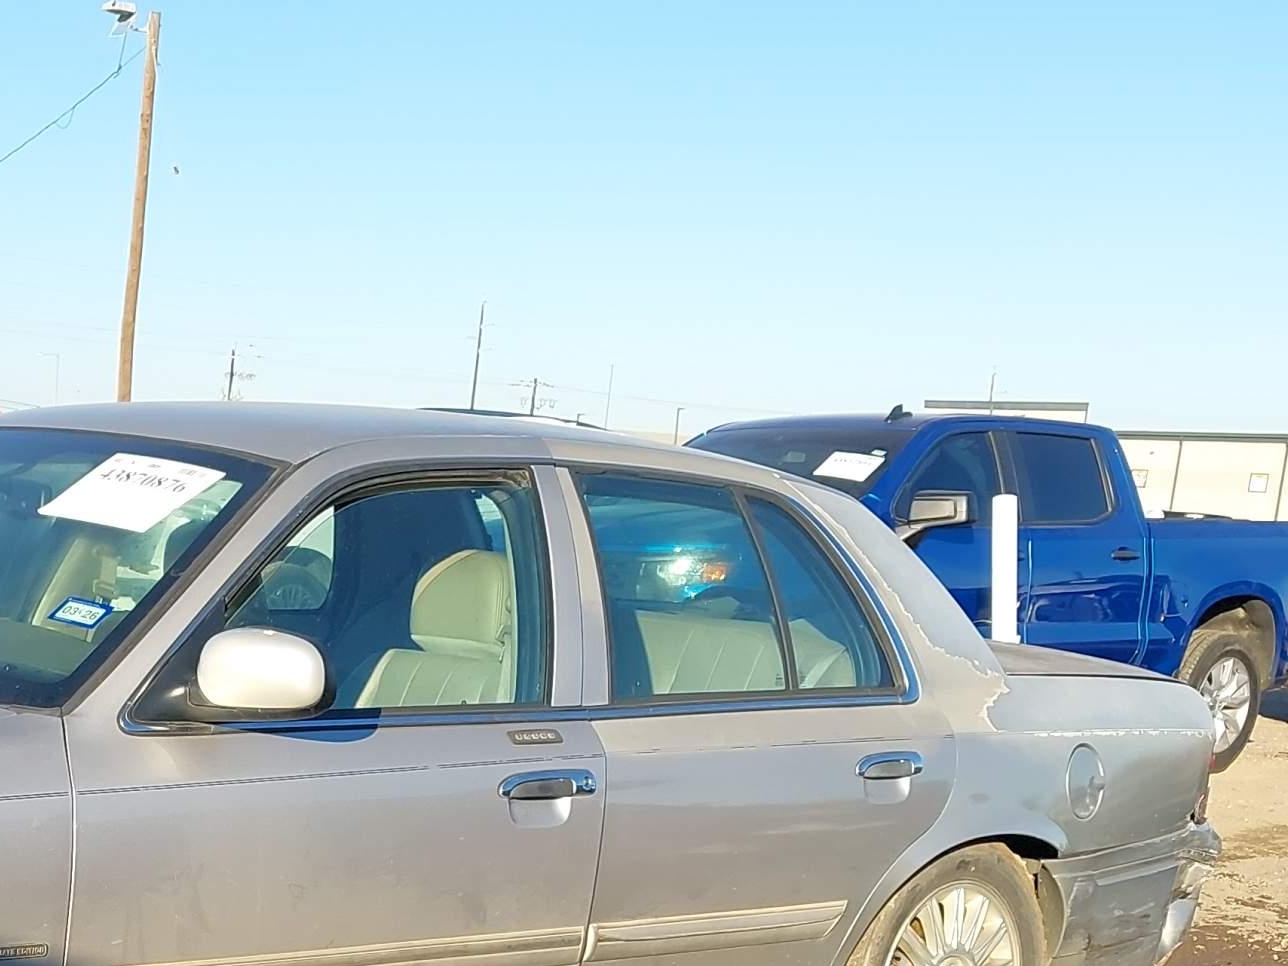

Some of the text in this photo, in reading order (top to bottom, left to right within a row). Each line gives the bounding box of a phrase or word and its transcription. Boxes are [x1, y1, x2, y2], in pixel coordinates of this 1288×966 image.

[99, 468, 187, 494] 43870876
[62, 605, 99, 621] 03 26
